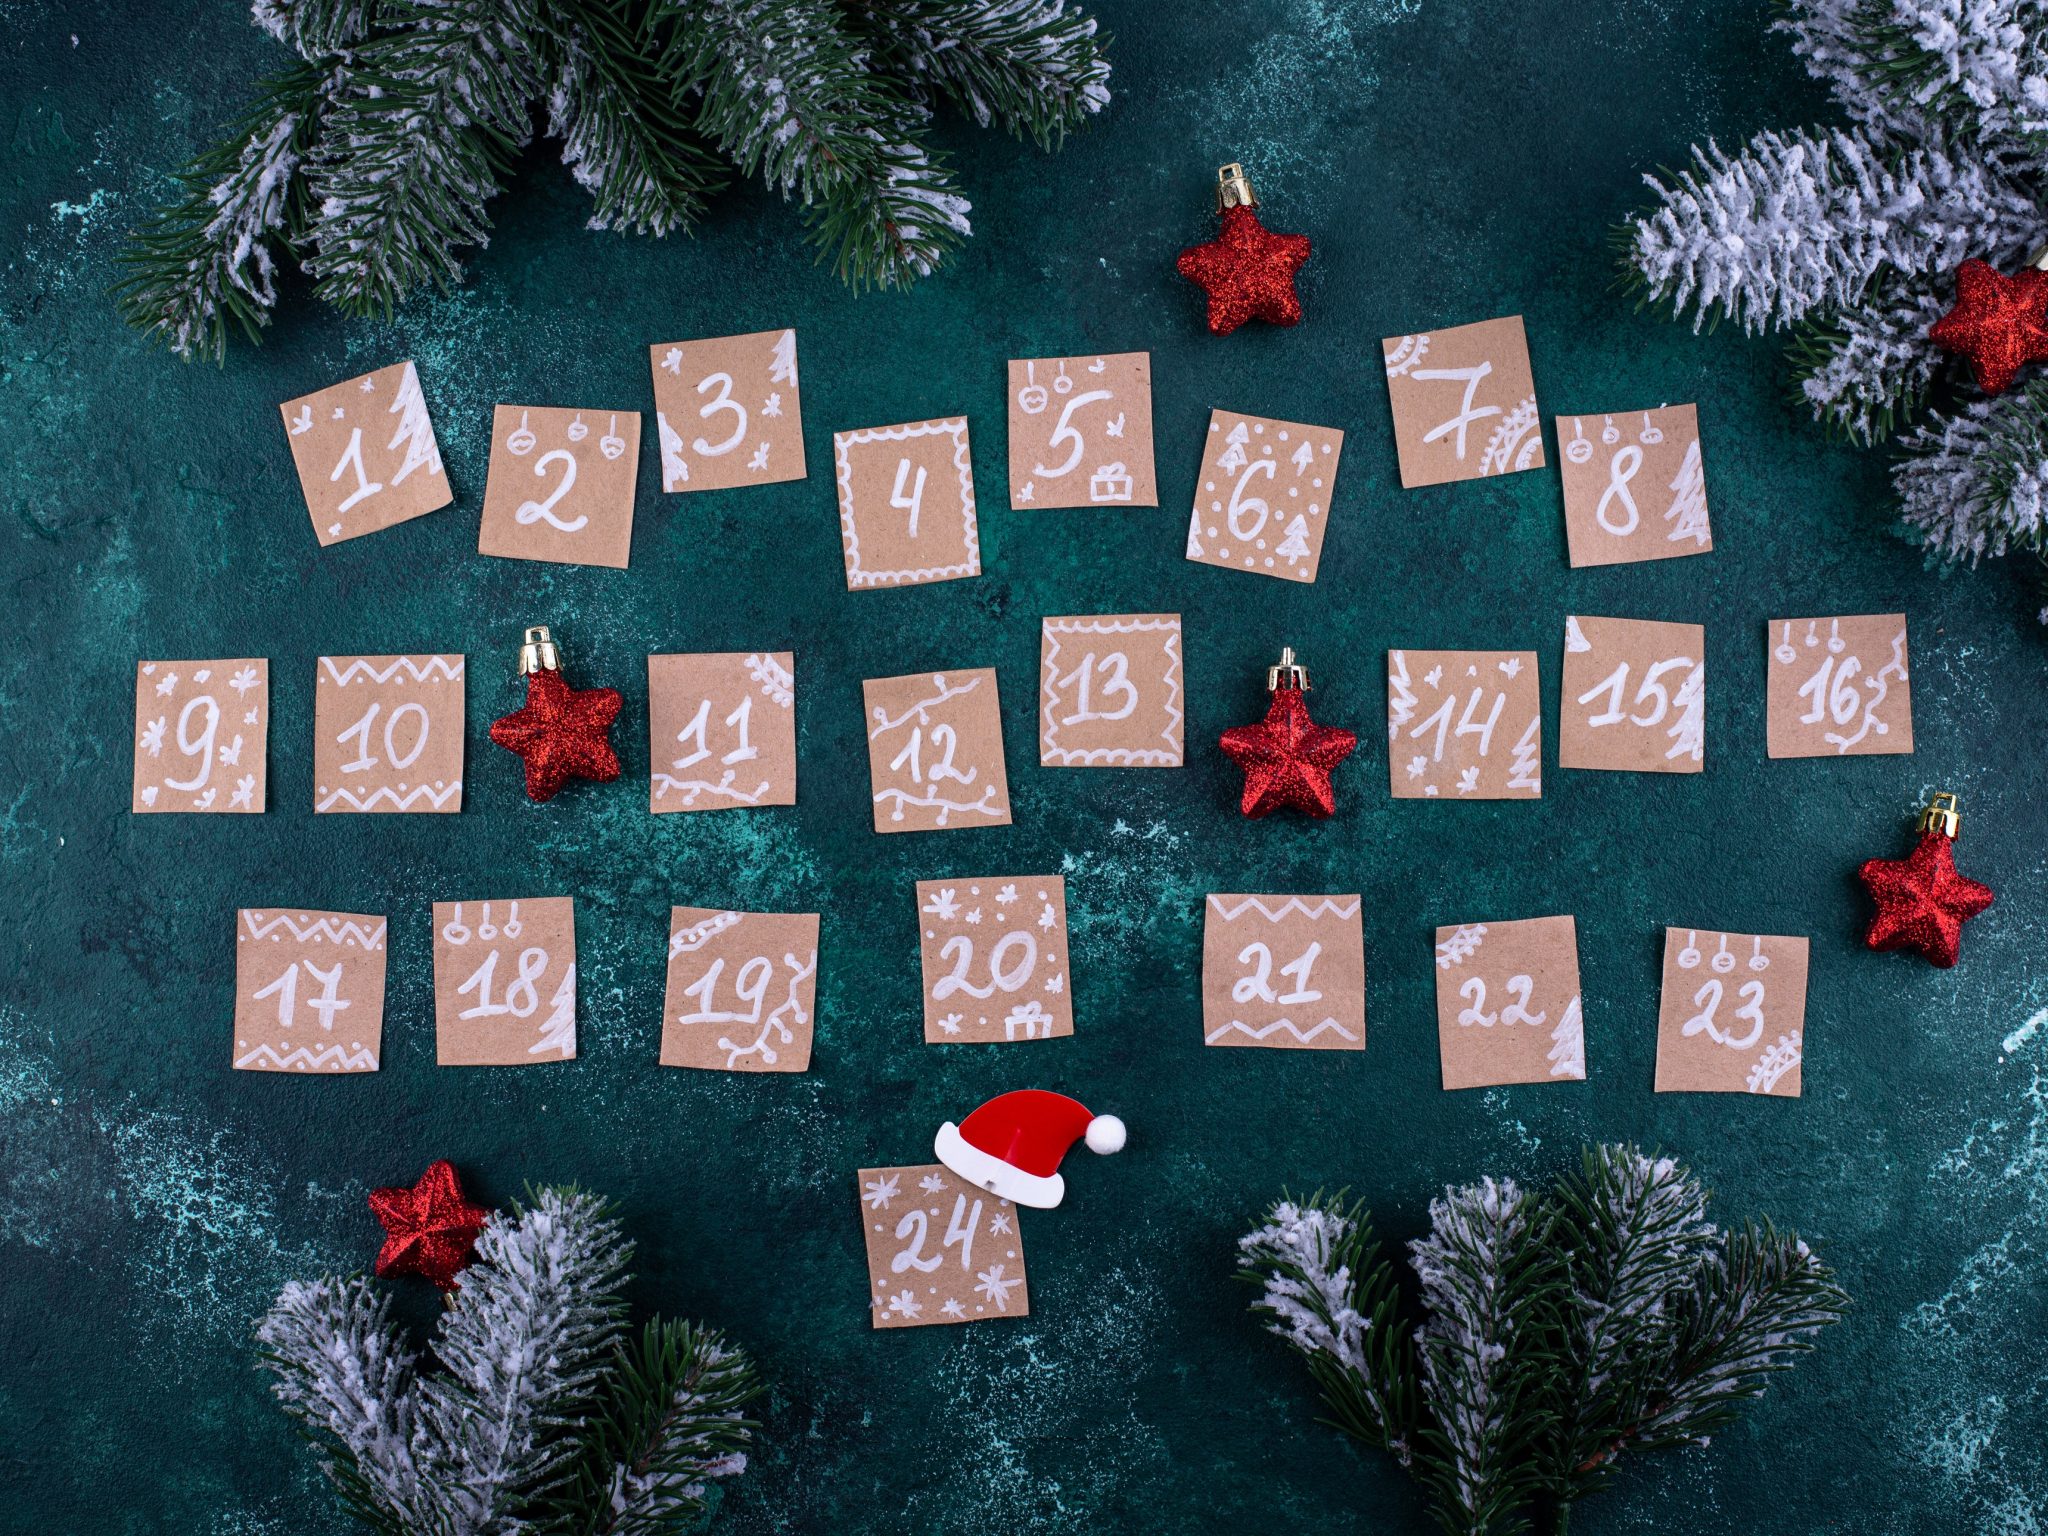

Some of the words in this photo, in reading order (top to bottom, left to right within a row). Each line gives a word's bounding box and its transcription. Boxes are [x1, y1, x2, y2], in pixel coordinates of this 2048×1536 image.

[692, 371, 748, 456] 3
[1034, 388, 1113, 479] 5
[1410, 361, 1503, 460] 7
[330, 427, 382, 513] 1
[515, 448, 589, 533] 2
[889, 457, 926, 538] 4
[1226, 458, 1277, 542] 6
[1595, 445, 1643, 537] 8
[1057, 650, 1139, 722] 13
[1578, 656, 1693, 729] 15
[1797, 655, 1863, 727] 16
[165, 695, 220, 793] 9
[336, 701, 427, 773] 10
[676, 696, 758, 768] 11
[888, 726, 977, 785] 12
[1415, 686, 1507, 764] 14
[253, 957, 351, 1031] 17
[457, 944, 549, 1018] 18
[680, 954, 772, 1026] 19
[931, 929, 1039, 1003] 20
[1233, 940, 1324, 1006] 21
[1459, 974, 1545, 1029] 22
[1681, 978, 1765, 1051] 23
[891, 1192, 984, 1274] 24
